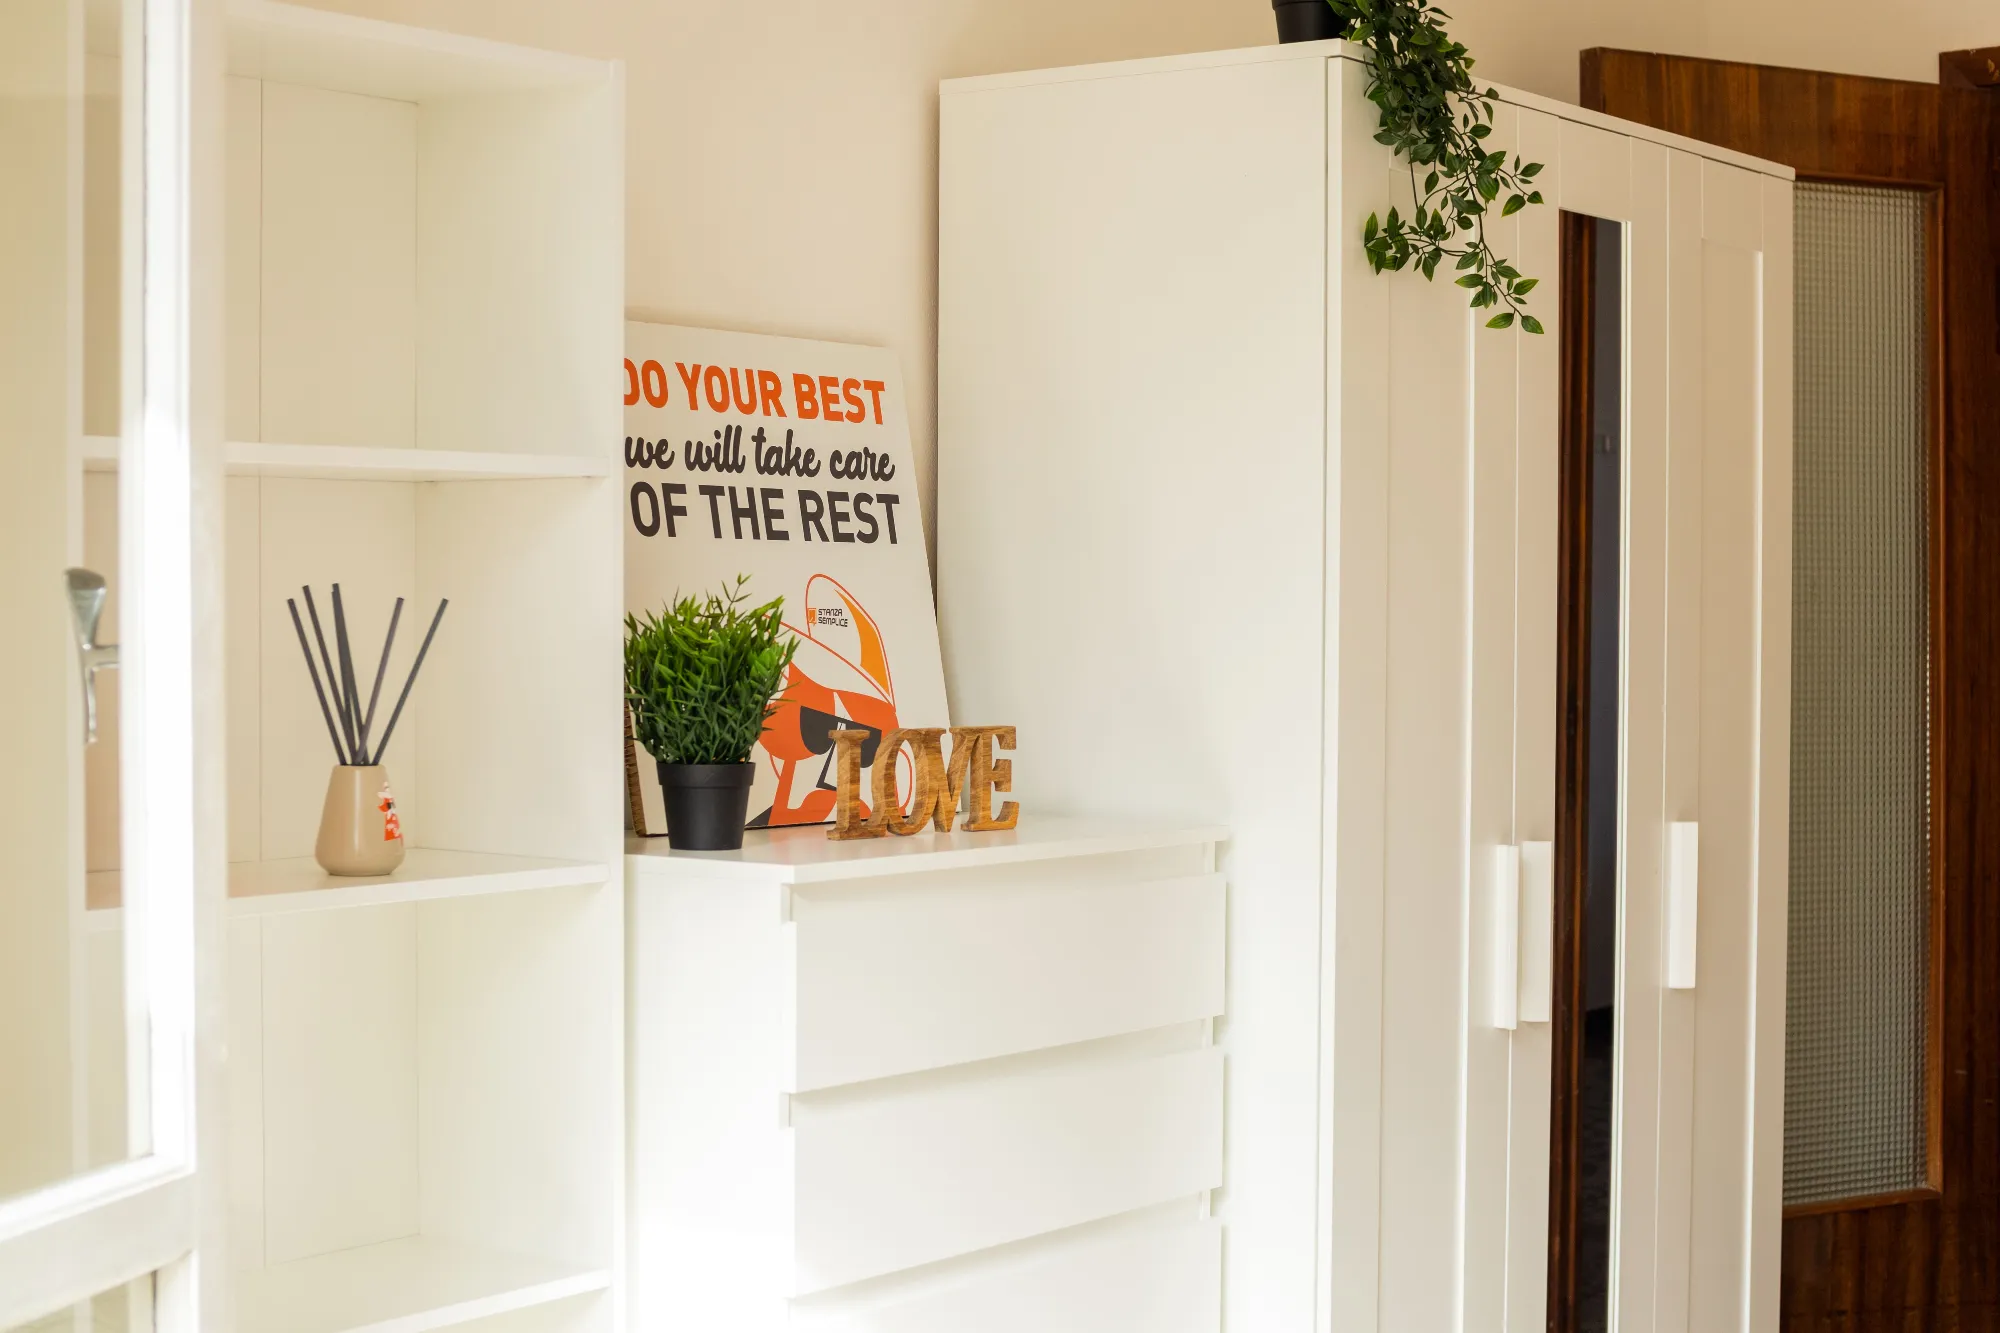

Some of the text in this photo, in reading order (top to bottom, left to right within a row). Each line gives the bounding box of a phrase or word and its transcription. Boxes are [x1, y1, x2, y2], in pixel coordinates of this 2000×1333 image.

[624, 357, 886, 425] DO YOUR BEST
[624, 424, 896, 482] we will take care
[630, 481, 900, 545] OF THE REST
[818, 608, 843, 617] STANZA
[818, 616, 848, 627] SEMPLICE
[827, 725, 1020, 841] LOVE
